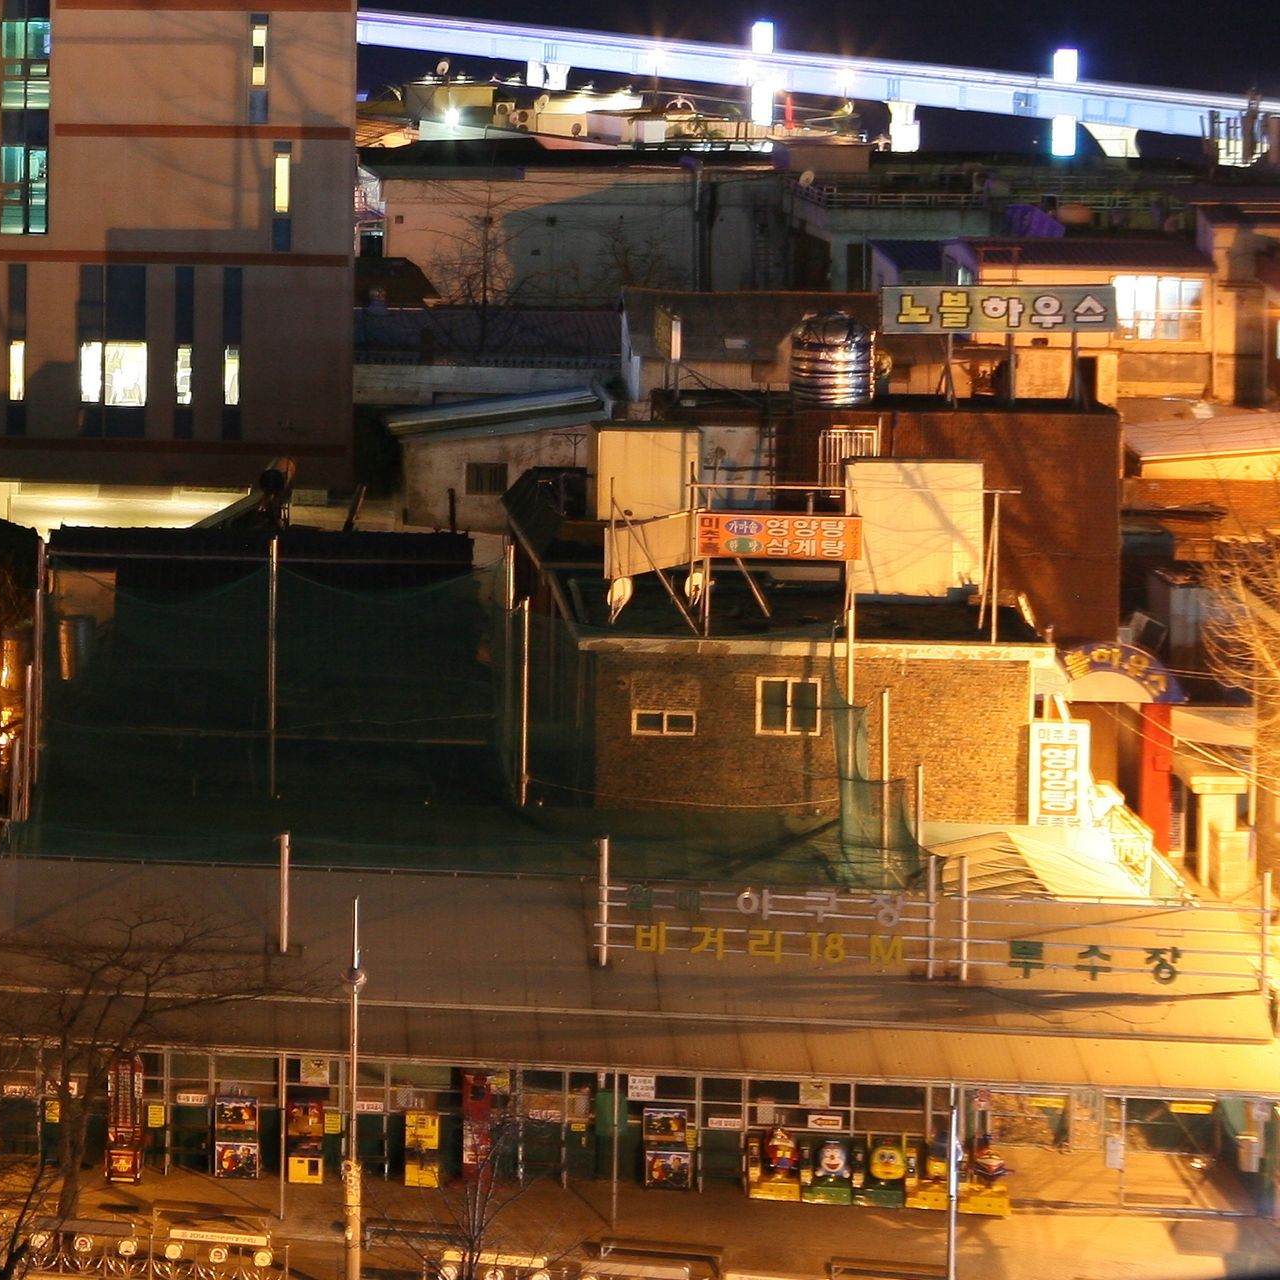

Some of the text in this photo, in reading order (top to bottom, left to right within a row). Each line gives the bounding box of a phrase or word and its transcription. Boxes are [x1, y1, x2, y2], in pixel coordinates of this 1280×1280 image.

[897, 290, 1108, 328] 노블하우스
[766, 519, 846, 537] 영양탕
[766, 538, 846, 558] 삼계탕
